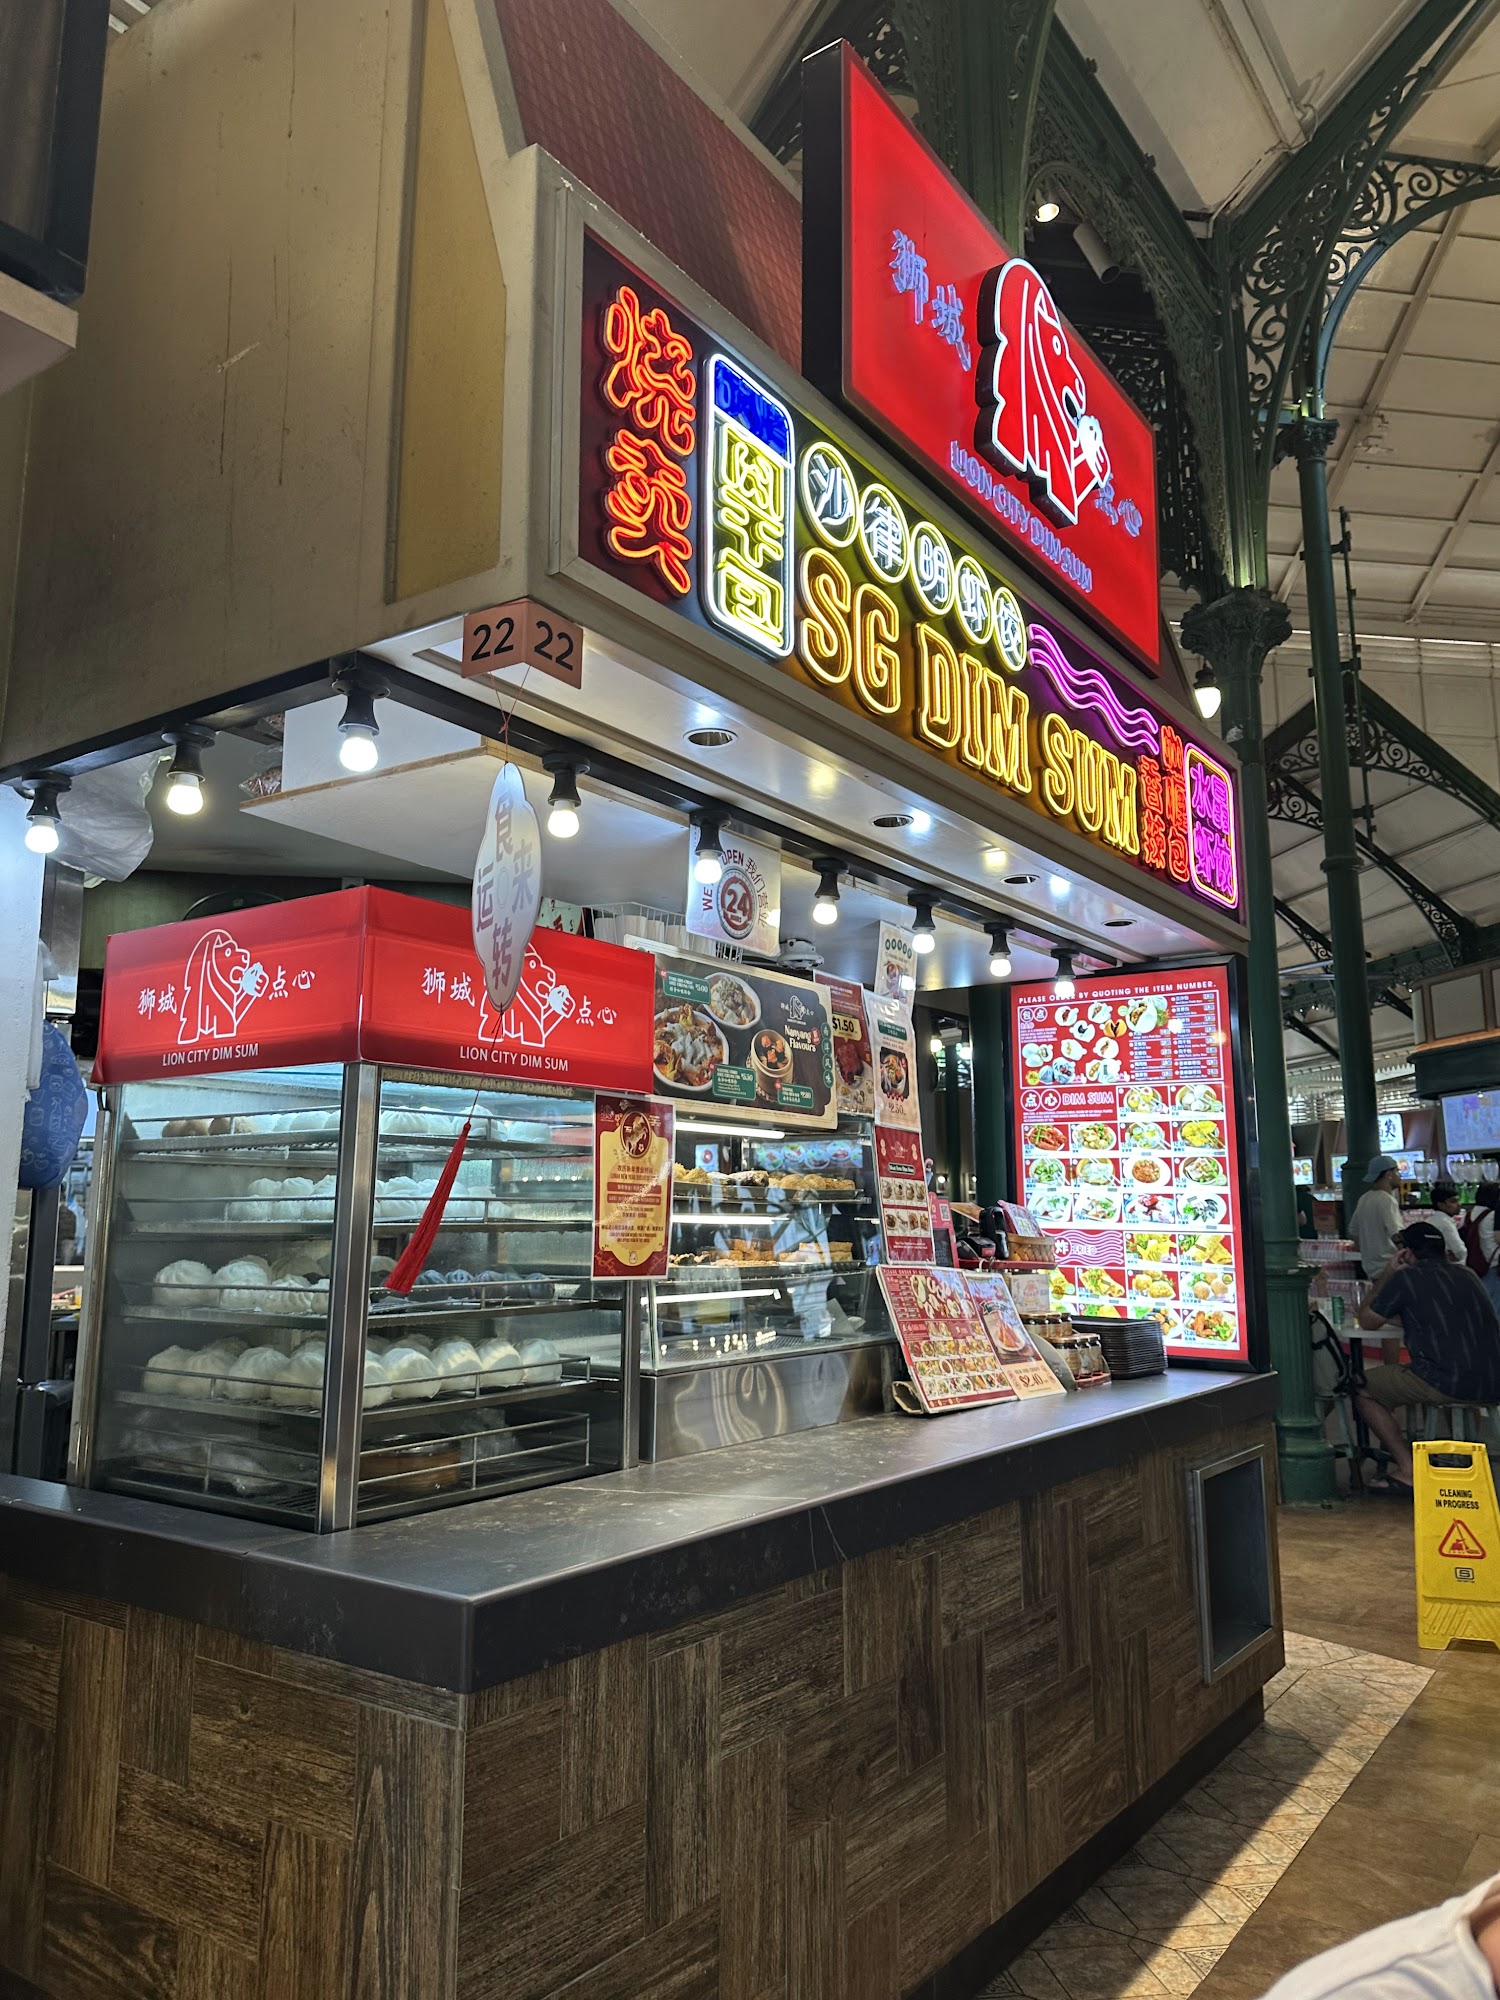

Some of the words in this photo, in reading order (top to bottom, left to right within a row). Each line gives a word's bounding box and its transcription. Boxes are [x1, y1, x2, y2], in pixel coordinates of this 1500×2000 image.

[889, 229, 972, 371] 狮城
[951, 440, 993, 500] LION
[993, 484, 1032, 534] CITY
[1030, 517, 1062, 565] DIM
[1061, 547, 1093, 593] SUM
[471, 617, 514, 661] 22
[534, 621, 574, 671] 22
[800, 547, 901, 714] SG
[918, 622, 1033, 795] DIM
[1042, 713, 1140, 857] SUM
[1190, 762, 1230, 835] 水晶
[702, 887, 713, 911] WE
[722, 849, 744, 866] OPEN
[726, 889, 749, 917] 24
[137, 983, 177, 1020] 狮城
[268, 965, 315, 1000] 点心
[421, 967, 475, 1007] 狮城
[575, 995, 617, 1027] 点心
[1019, 995, 1046, 1004] PLEASE
[1078, 991, 1089, 999] BY
[1092, 987, 1132, 998] QUOTING
[1134, 986, 1150, 994] THE
[1153, 984, 1173, 993] ITEM
[1176, 980, 1217, 990] NUMBER.
[784, 1025, 812, 1044] Nanyang
[832, 1015, 855, 1033] $1.50
[162, 1052, 185, 1067] LION
[187, 1049, 211, 1063] CITY
[212, 1046, 233, 1061] DIM
[235, 1043, 259, 1058] SUM
[460, 1045, 488, 1061] LION
[491, 1050, 518, 1065] CITY
[520, 1053, 542, 1068] DIM
[544, 1057, 568, 1072] SUM
[790, 1038, 817, 1053] Flavours
[1024, 1092, 1058, 1107] 点心
[1062, 1093, 1087, 1106] DIM
[1087, 1091, 1115, 1105] SUM
[1055, 1239, 1069, 1255] 炸
[1435, 1499, 1443, 1508] IN
[1443, 1499, 1480, 1510] PROGRESS
[1439, 1488, 1473, 1499] CLEANING
